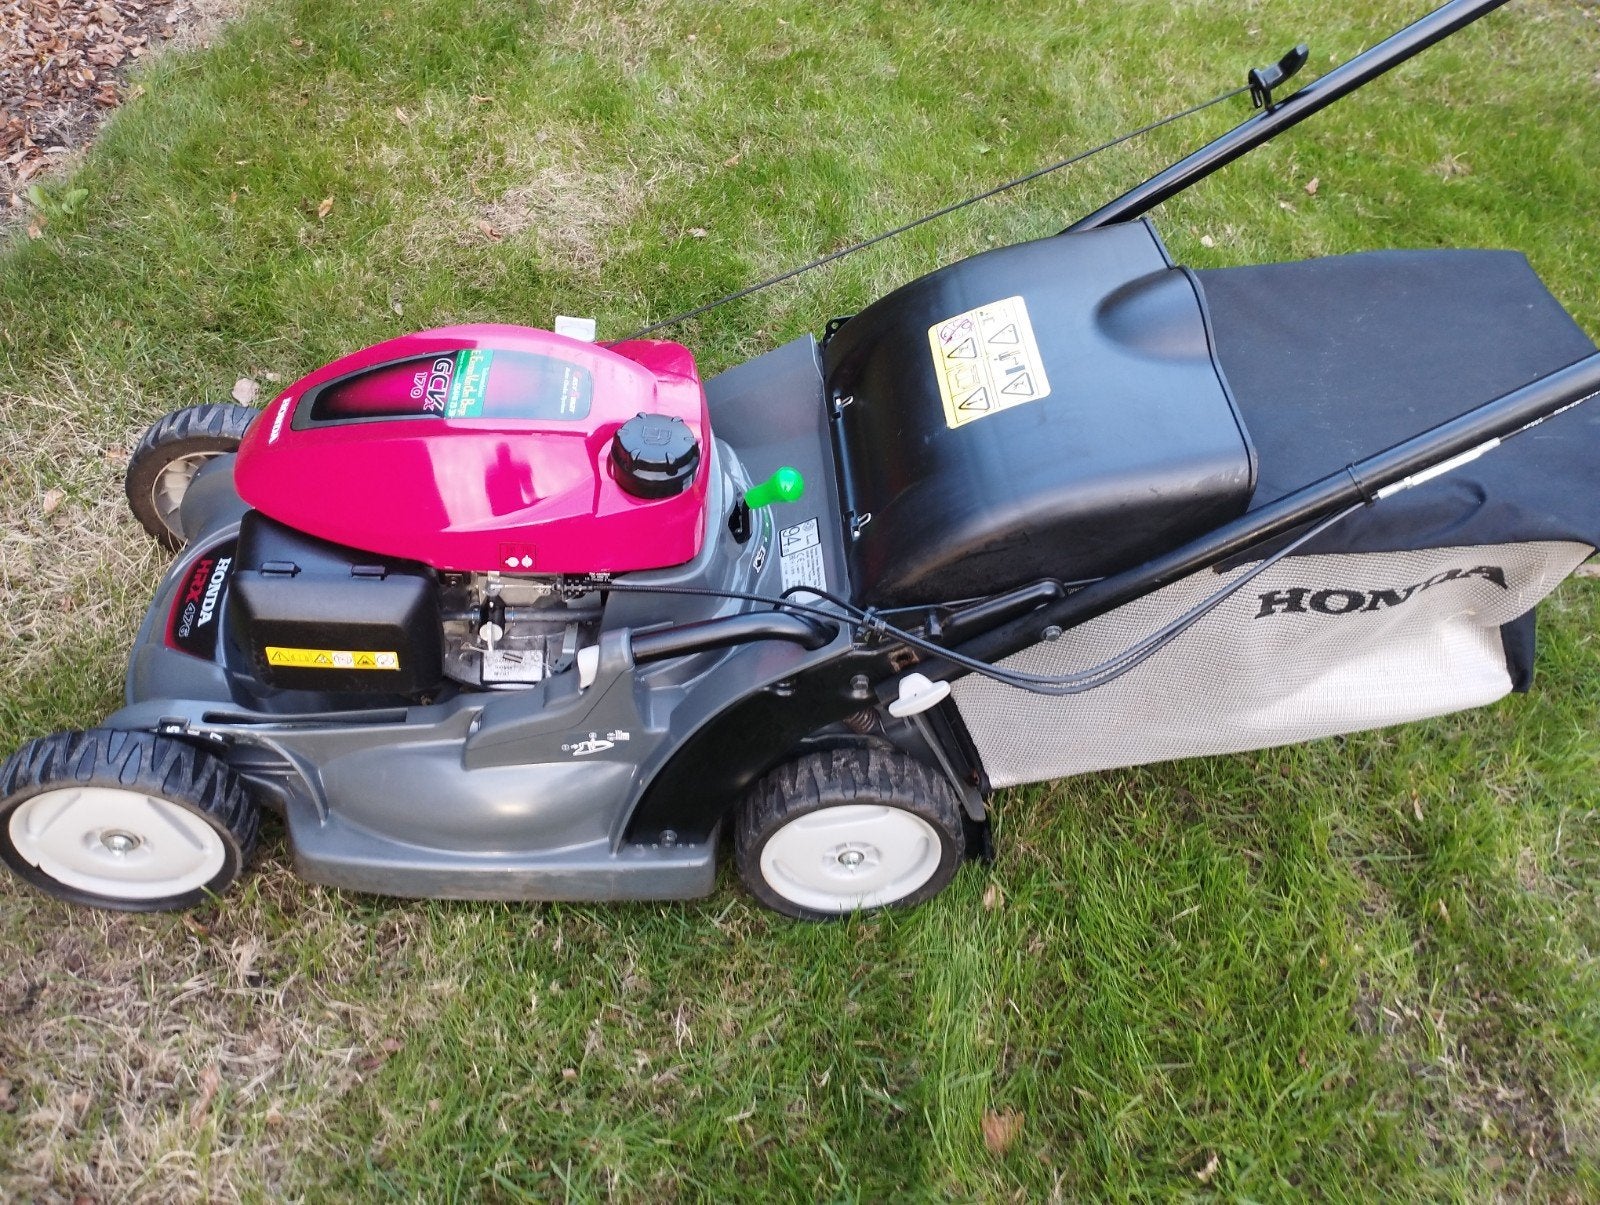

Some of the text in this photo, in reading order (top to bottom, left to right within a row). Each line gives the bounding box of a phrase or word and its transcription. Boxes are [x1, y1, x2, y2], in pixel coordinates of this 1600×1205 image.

[410, 372, 428, 399] 170
[268, 396, 292, 445] HONDA
[185, 559, 214, 603] HRX
[197, 557, 232, 628] HONDA
